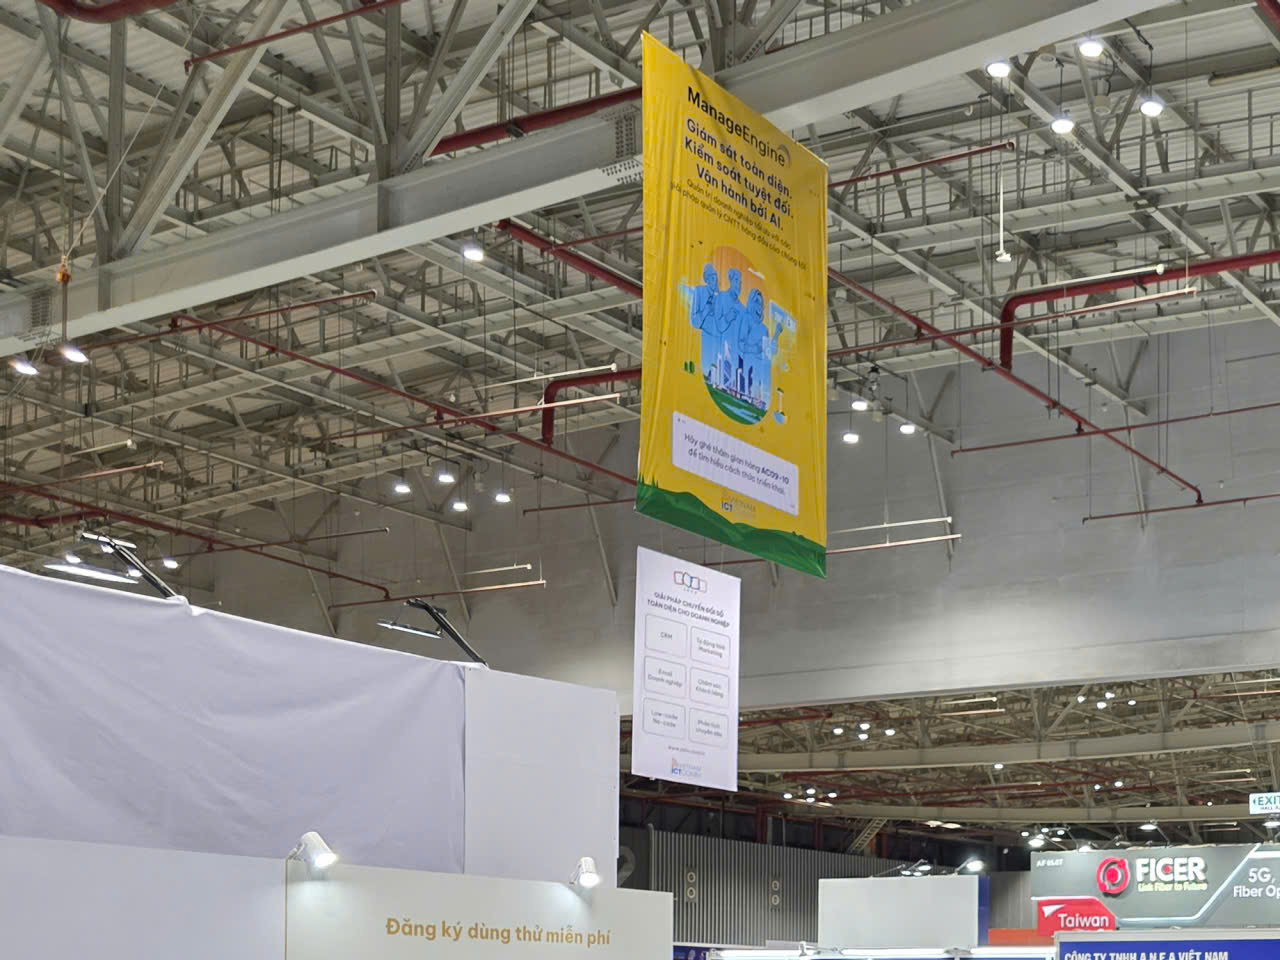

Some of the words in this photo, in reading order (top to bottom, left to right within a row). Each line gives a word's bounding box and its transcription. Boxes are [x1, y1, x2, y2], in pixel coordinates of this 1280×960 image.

[687, 86, 786, 167] ManageEngine
[687, 118, 717, 149] Giám
[720, 143, 738, 163] sát
[740, 154, 766, 180] toàn
[767, 174, 793, 200] diện.
[685, 135, 714, 166] Kiểm
[716, 160, 741, 185] soát
[744, 176, 771, 205] tuyệt
[774, 197, 794, 219] đối.
[696, 163, 719, 188] Vận
[721, 179, 747, 208] hành
[750, 199, 767, 220] bởi
[769, 213, 783, 232] AI.
[647, 598, 664, 610] TOÀN
[678, 606, 691, 617] CHO
[1135, 856, 1206, 883] FICER
[1248, 868, 1276, 884] 5G,
[1154, 882, 1173, 891] Fiber
[1233, 884, 1262, 898] Fiber
[386, 918, 436, 940] Đăng
[441, 921, 463, 940] ký
[468, 923, 511, 943] dùng
[515, 925, 542, 943] thử
[546, 924, 582, 945] miễn
[587, 930, 610, 948] phí
[1057, 913, 1109, 928] Taiwan
